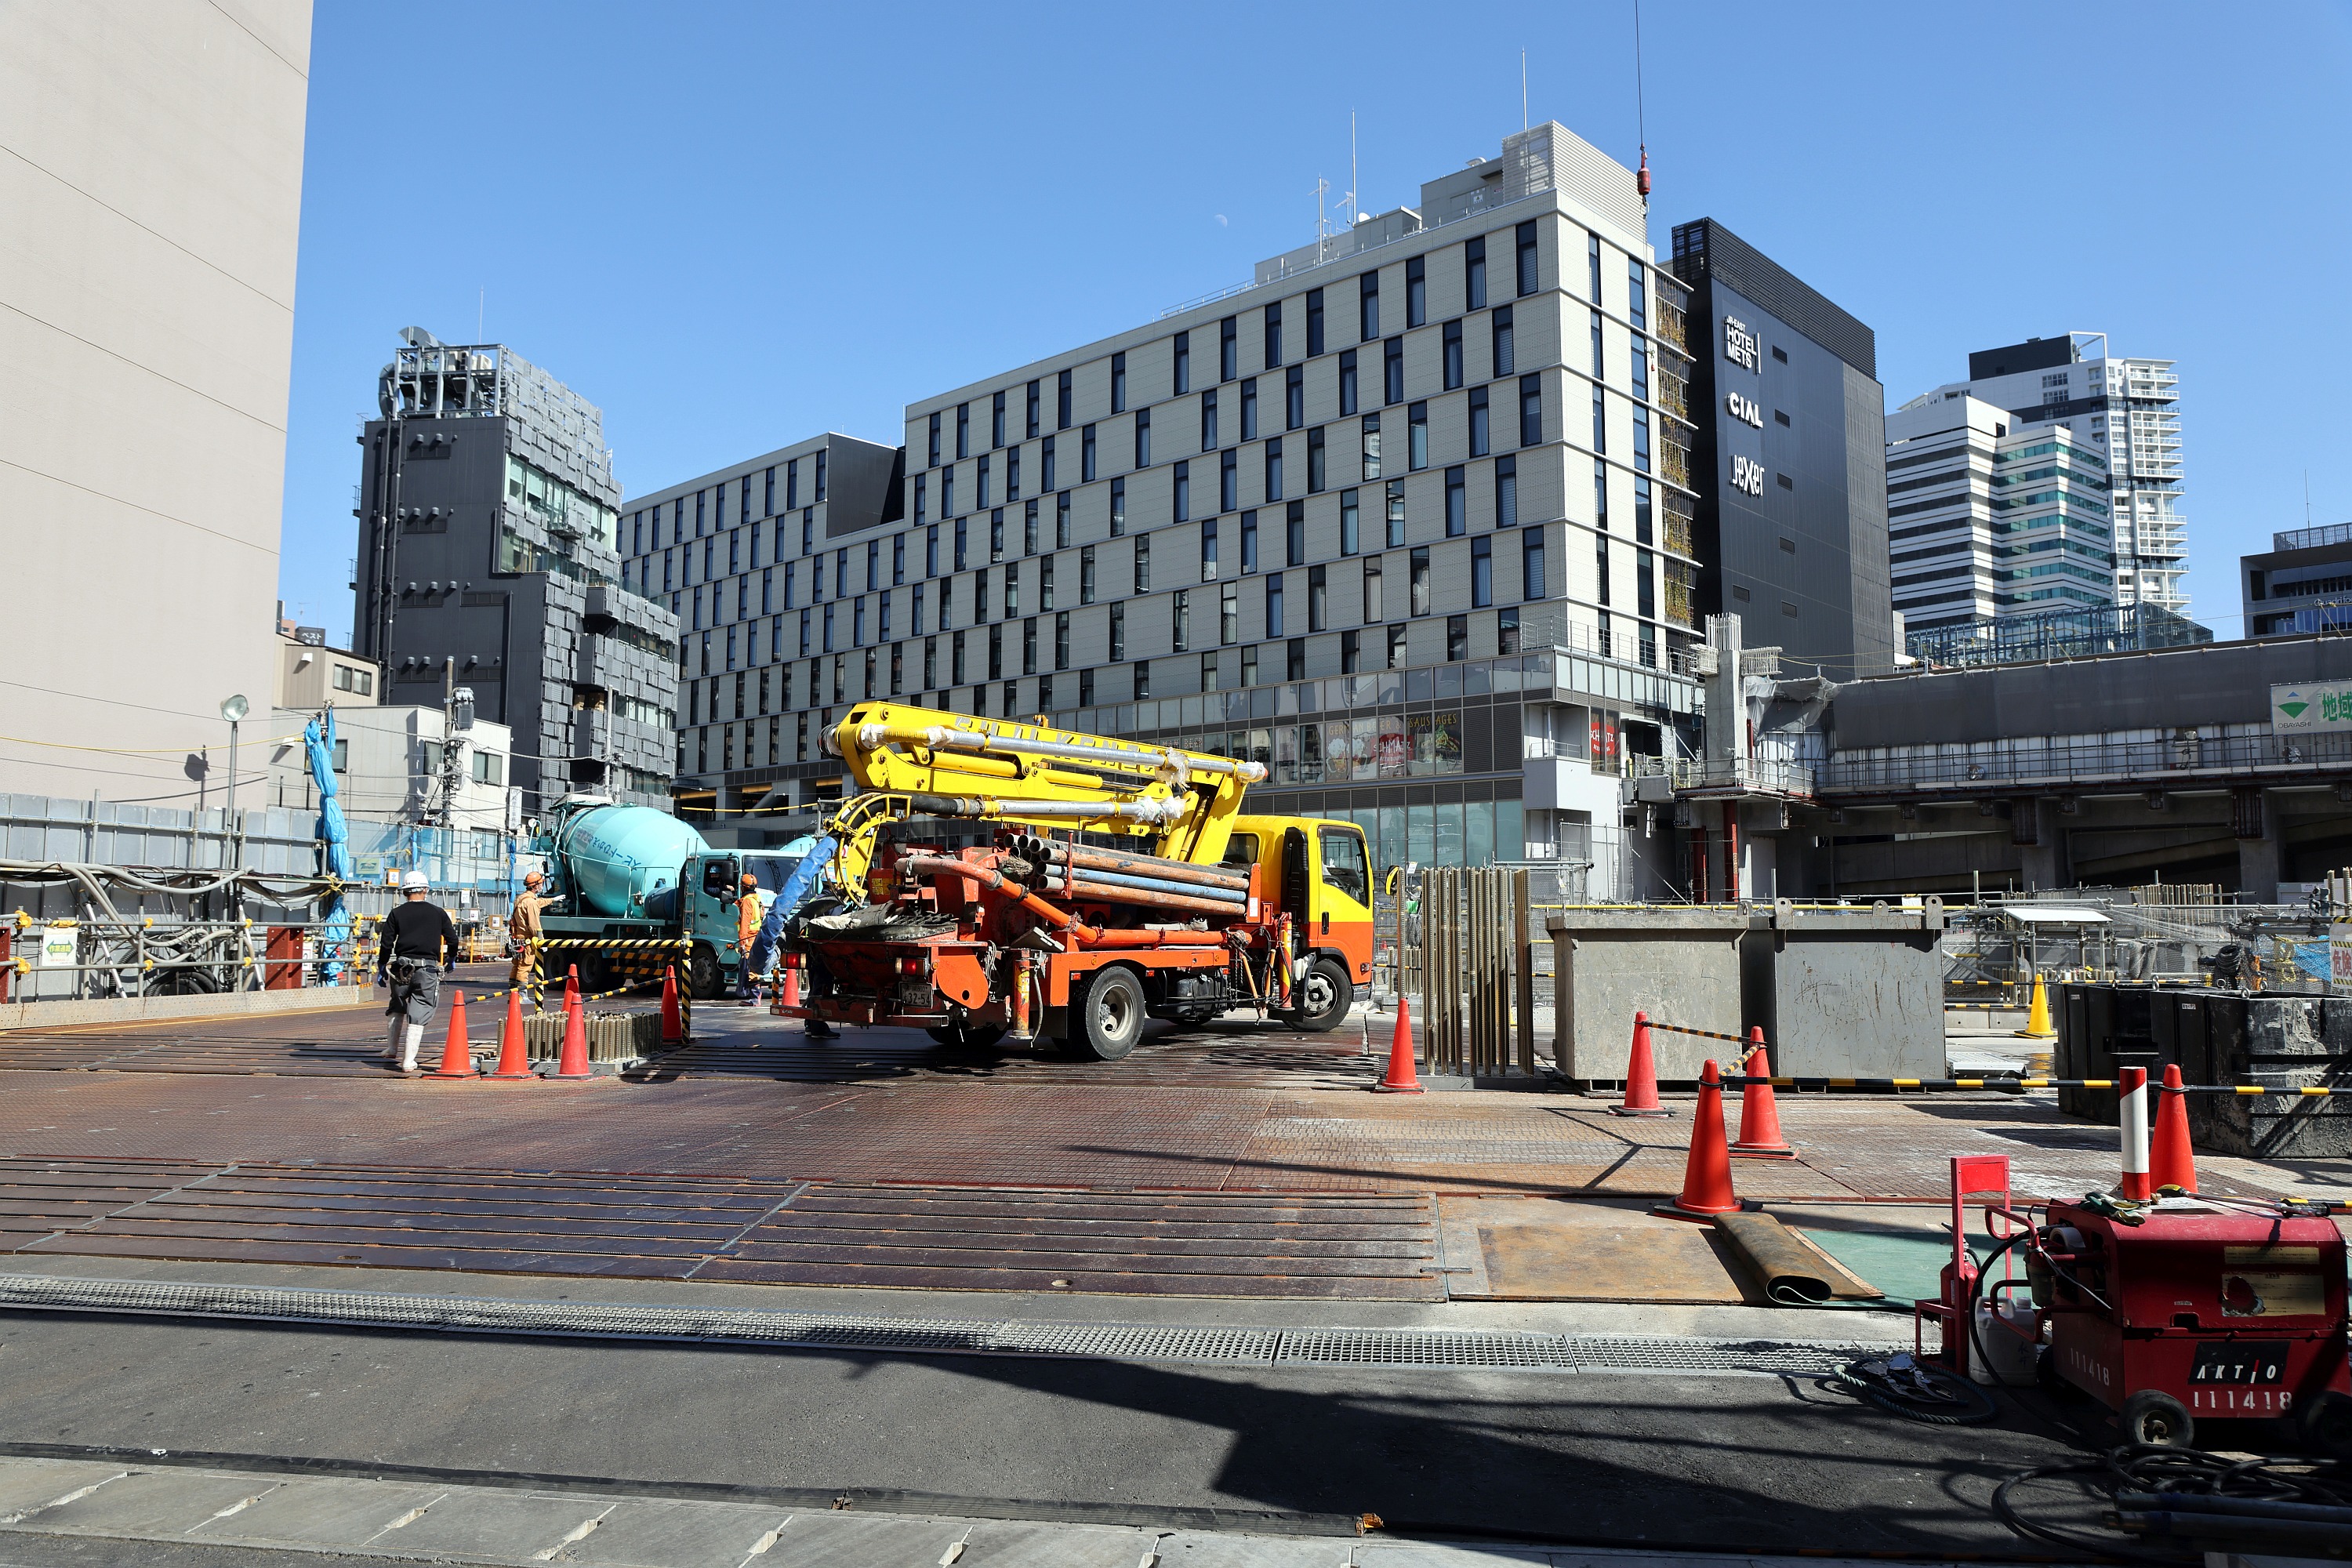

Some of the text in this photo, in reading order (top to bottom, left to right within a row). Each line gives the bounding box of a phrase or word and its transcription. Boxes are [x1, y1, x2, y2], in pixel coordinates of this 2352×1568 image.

[1727, 325, 1757, 356] HOTEL
[1728, 341, 1752, 368] METS
[1730, 392, 1763, 428] CIAL
[1409, 713, 1457, 728] SAUSAGES
[2278, 720, 2312, 729] OBAYASHI
[2071, 1347, 2110, 1387] 111418
[2197, 1359, 2277, 1385] AKTIO
[2194, 1390, 2292, 1410] 111418
